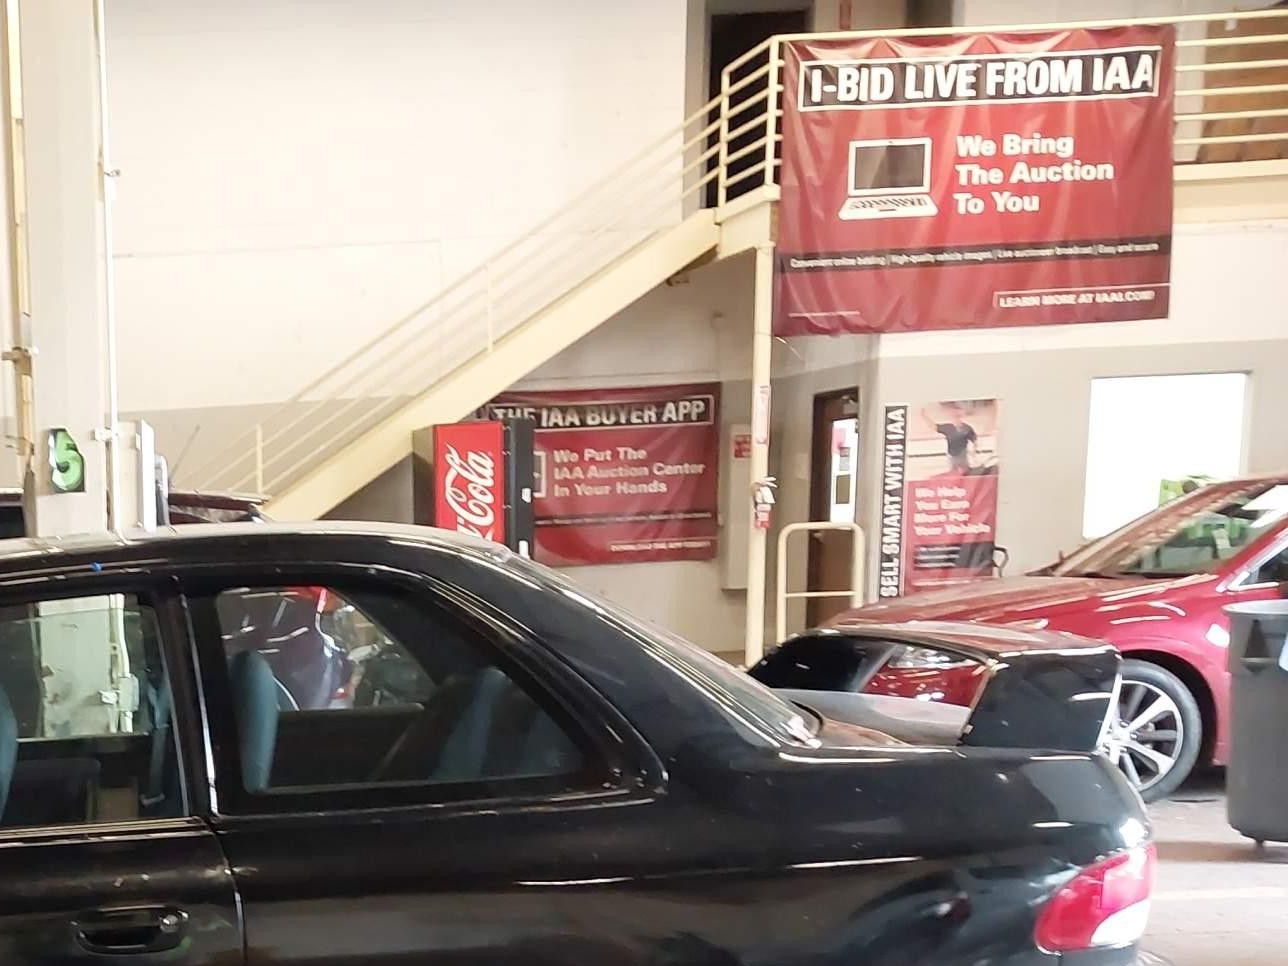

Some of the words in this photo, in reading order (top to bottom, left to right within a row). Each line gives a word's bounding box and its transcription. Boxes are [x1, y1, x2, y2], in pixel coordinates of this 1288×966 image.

[811, 65, 894, 103] I-BID
[904, 62, 978, 100] LIVE
[986, 57, 1082, 97] FROM
[1093, 54, 1154, 92] IAA
[955, 135, 993, 158] We
[1003, 133, 1075, 157] Bring
[955, 164, 1004, 187] The
[1010, 160, 1115, 184] Auction
[954, 192, 985, 215] To
[992, 191, 1040, 214] You
[999, 295, 1041, 308] LEARN
[1041, 293, 1077, 306] MORE
[1078, 292, 1095, 304] AT
[540, 407, 582, 428] IAA
[586, 404, 658, 426] BUYER
[662, 400, 706, 423] APP
[886, 408, 906, 441] IAA
[553, 449, 580, 463] We
[583, 447, 612, 462] Put
[618, 446, 648, 461] The
[553, 467, 584, 480] IAA
[587, 465, 649, 479] Auction
[652, 461, 706, 477] Center
[884, 444, 904, 494] WITH
[554, 483, 570, 497] In
[574, 483, 611, 496] Your
[615, 480, 668, 495] Hands
[881, 495, 903, 555] SMART
[880, 556, 899, 598] SELL
